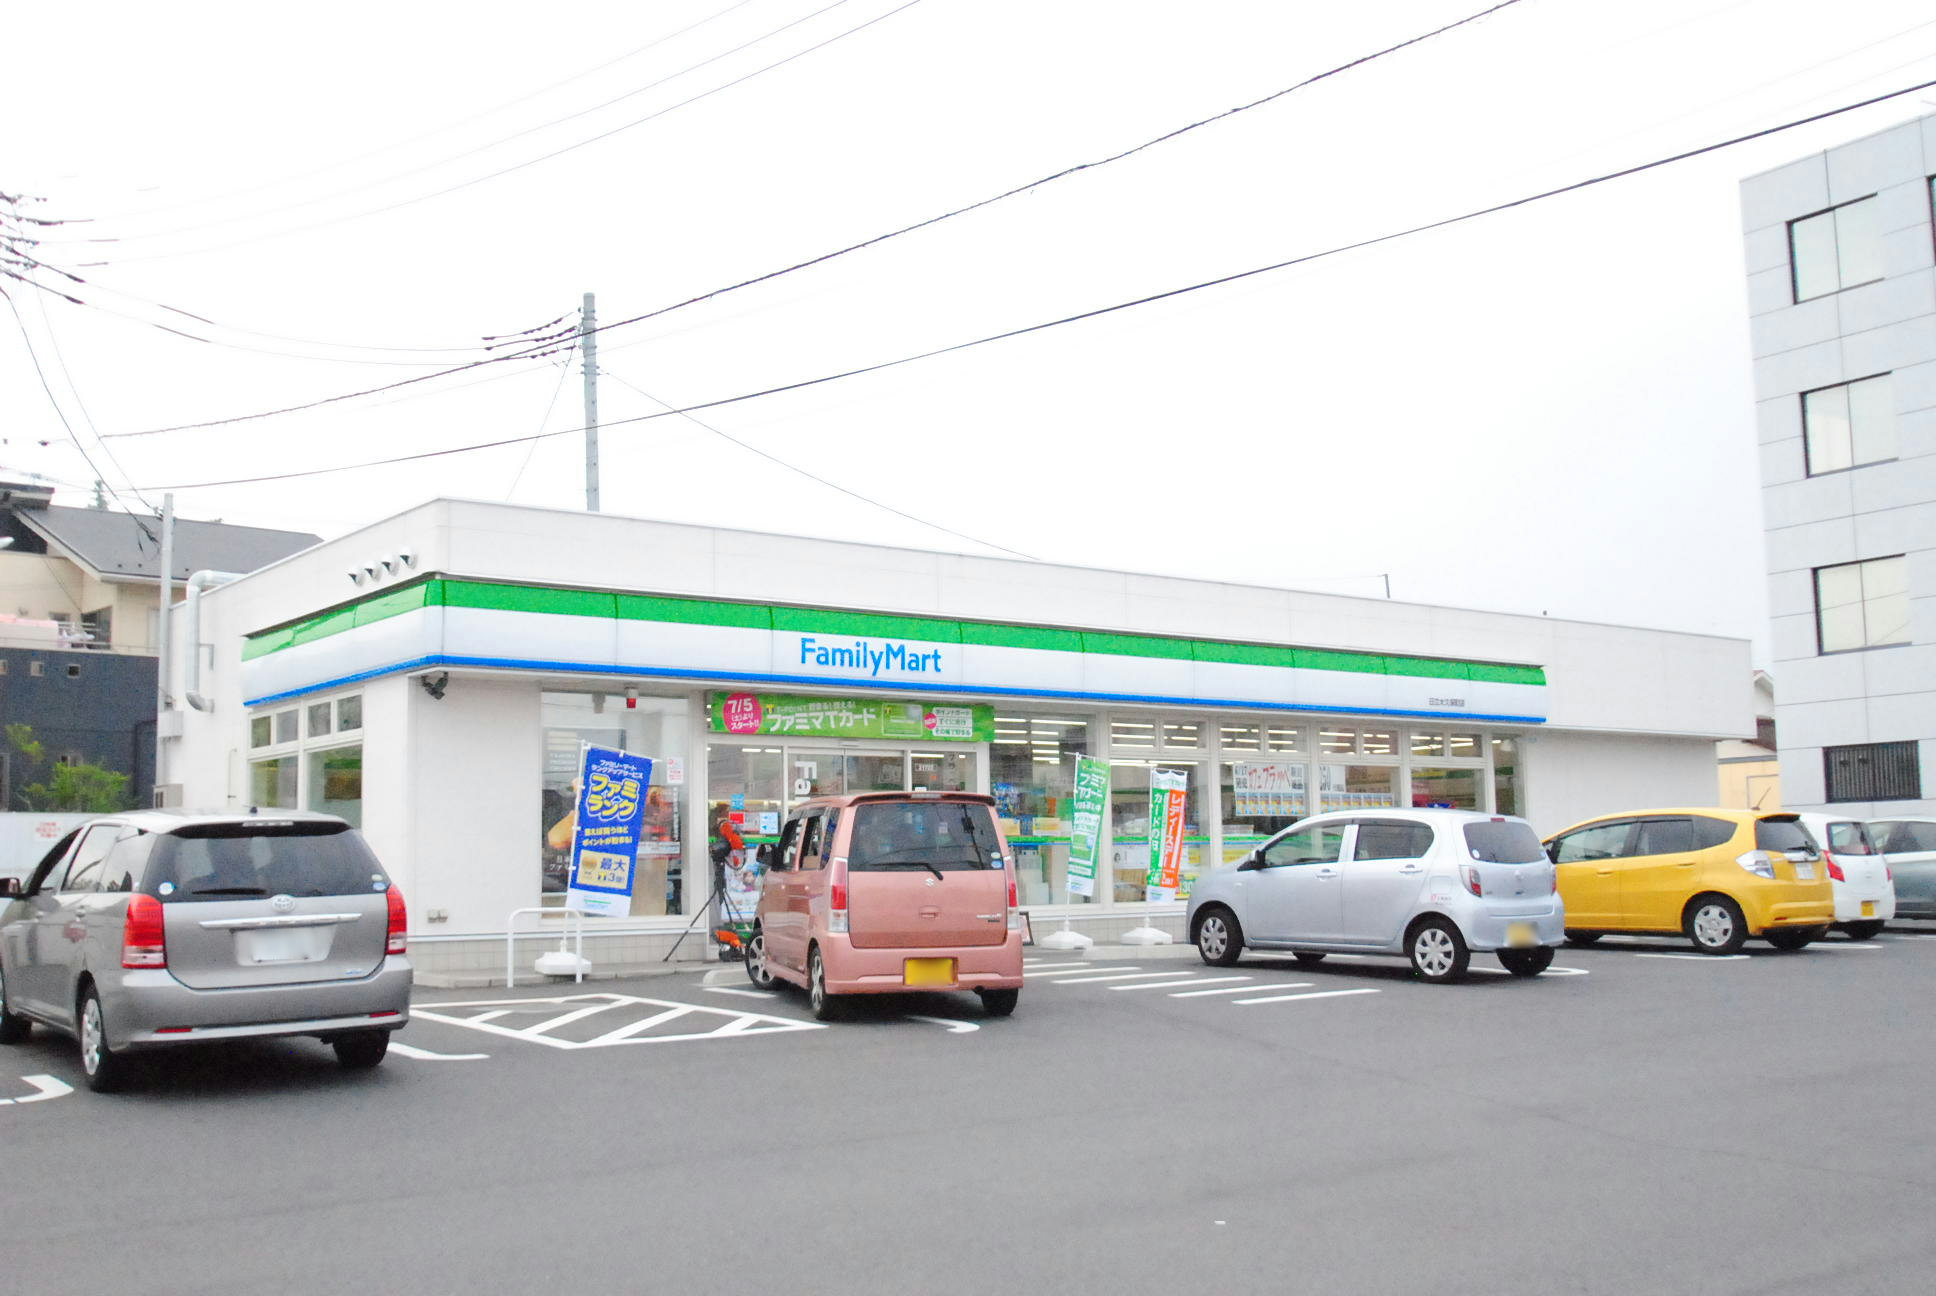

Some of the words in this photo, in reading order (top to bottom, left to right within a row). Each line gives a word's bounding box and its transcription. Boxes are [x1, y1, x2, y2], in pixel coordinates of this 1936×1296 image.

[801, 637, 942, 677] FamilyMart
[727, 698, 754, 714] 7/5
[766, 708, 876, 732] ファミマTカード
[591, 774, 638, 799] ファミ
[588, 794, 636, 817] ランク
